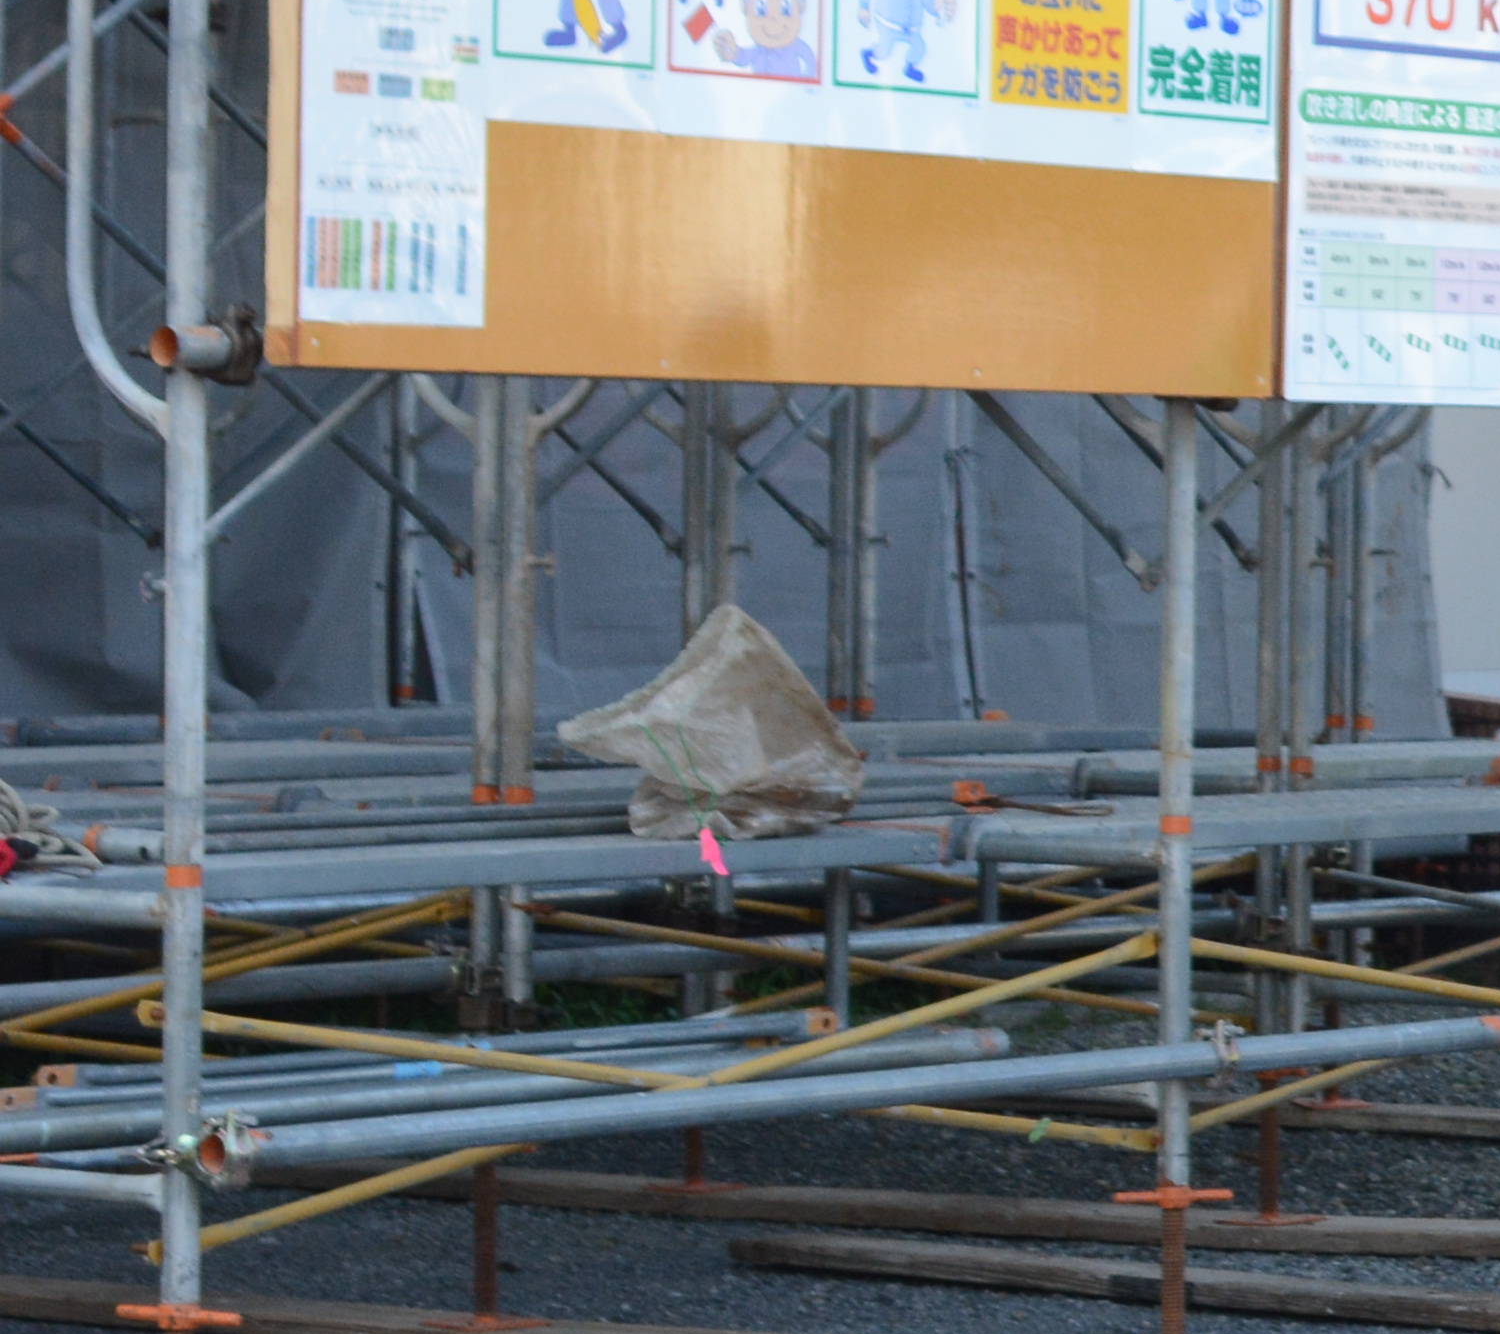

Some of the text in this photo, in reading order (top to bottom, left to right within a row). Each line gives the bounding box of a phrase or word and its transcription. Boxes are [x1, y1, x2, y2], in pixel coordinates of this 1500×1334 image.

[996, 13, 1123, 60] 声かけあって
[1148, 43, 1262, 107] 完全着用
